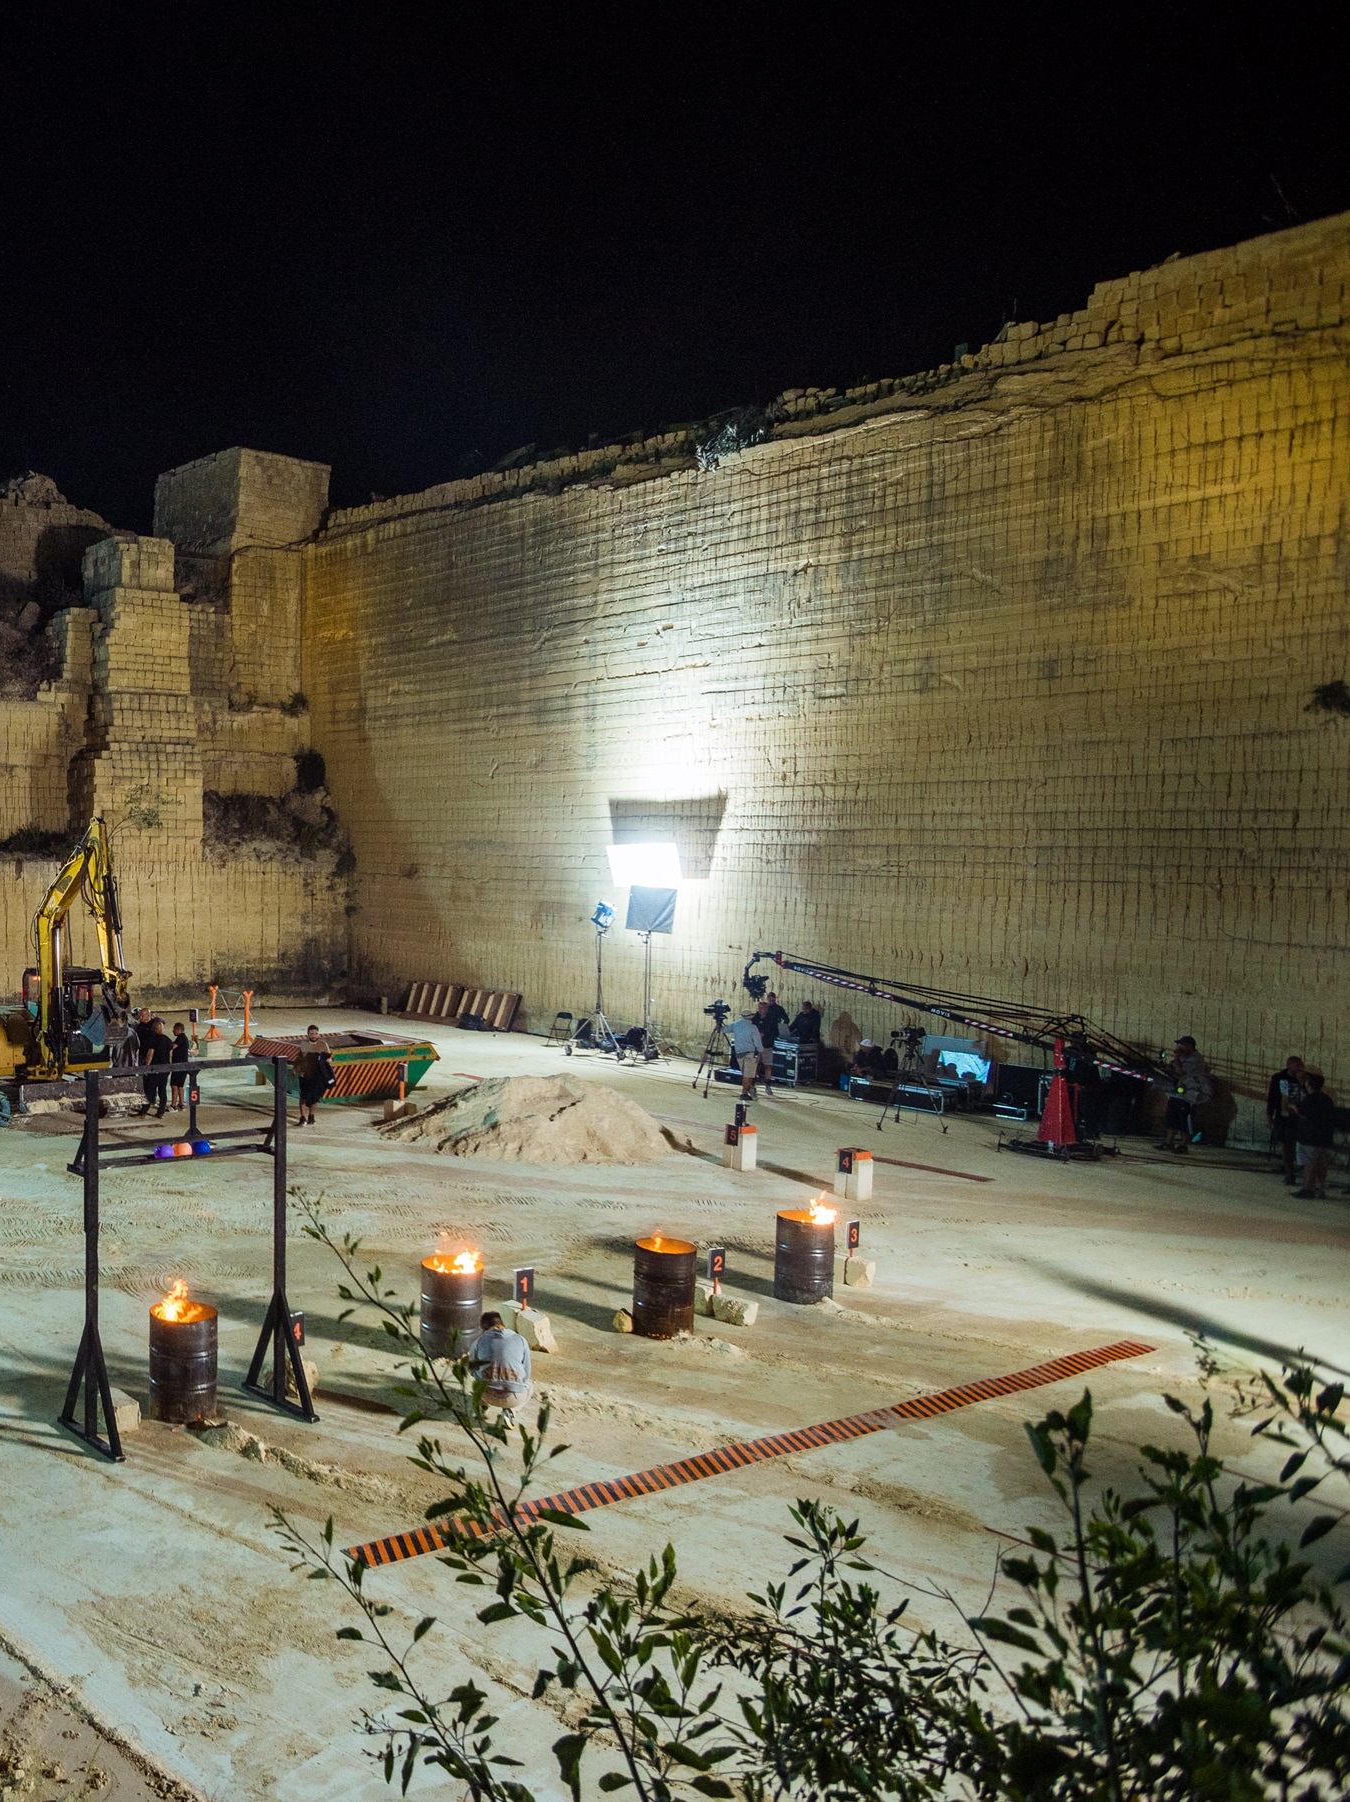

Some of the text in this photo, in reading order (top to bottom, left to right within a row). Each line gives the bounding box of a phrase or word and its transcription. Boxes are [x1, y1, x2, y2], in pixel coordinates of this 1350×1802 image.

[191, 1090, 198, 1101] 5
[730, 1129, 737, 1141] 5
[842, 1156, 850, 1168] 4
[850, 1228, 858, 1242] 3
[713, 1255, 723, 1271] 2
[520, 1276, 528, 1293] 1
[293, 1322, 301, 1340] 4
